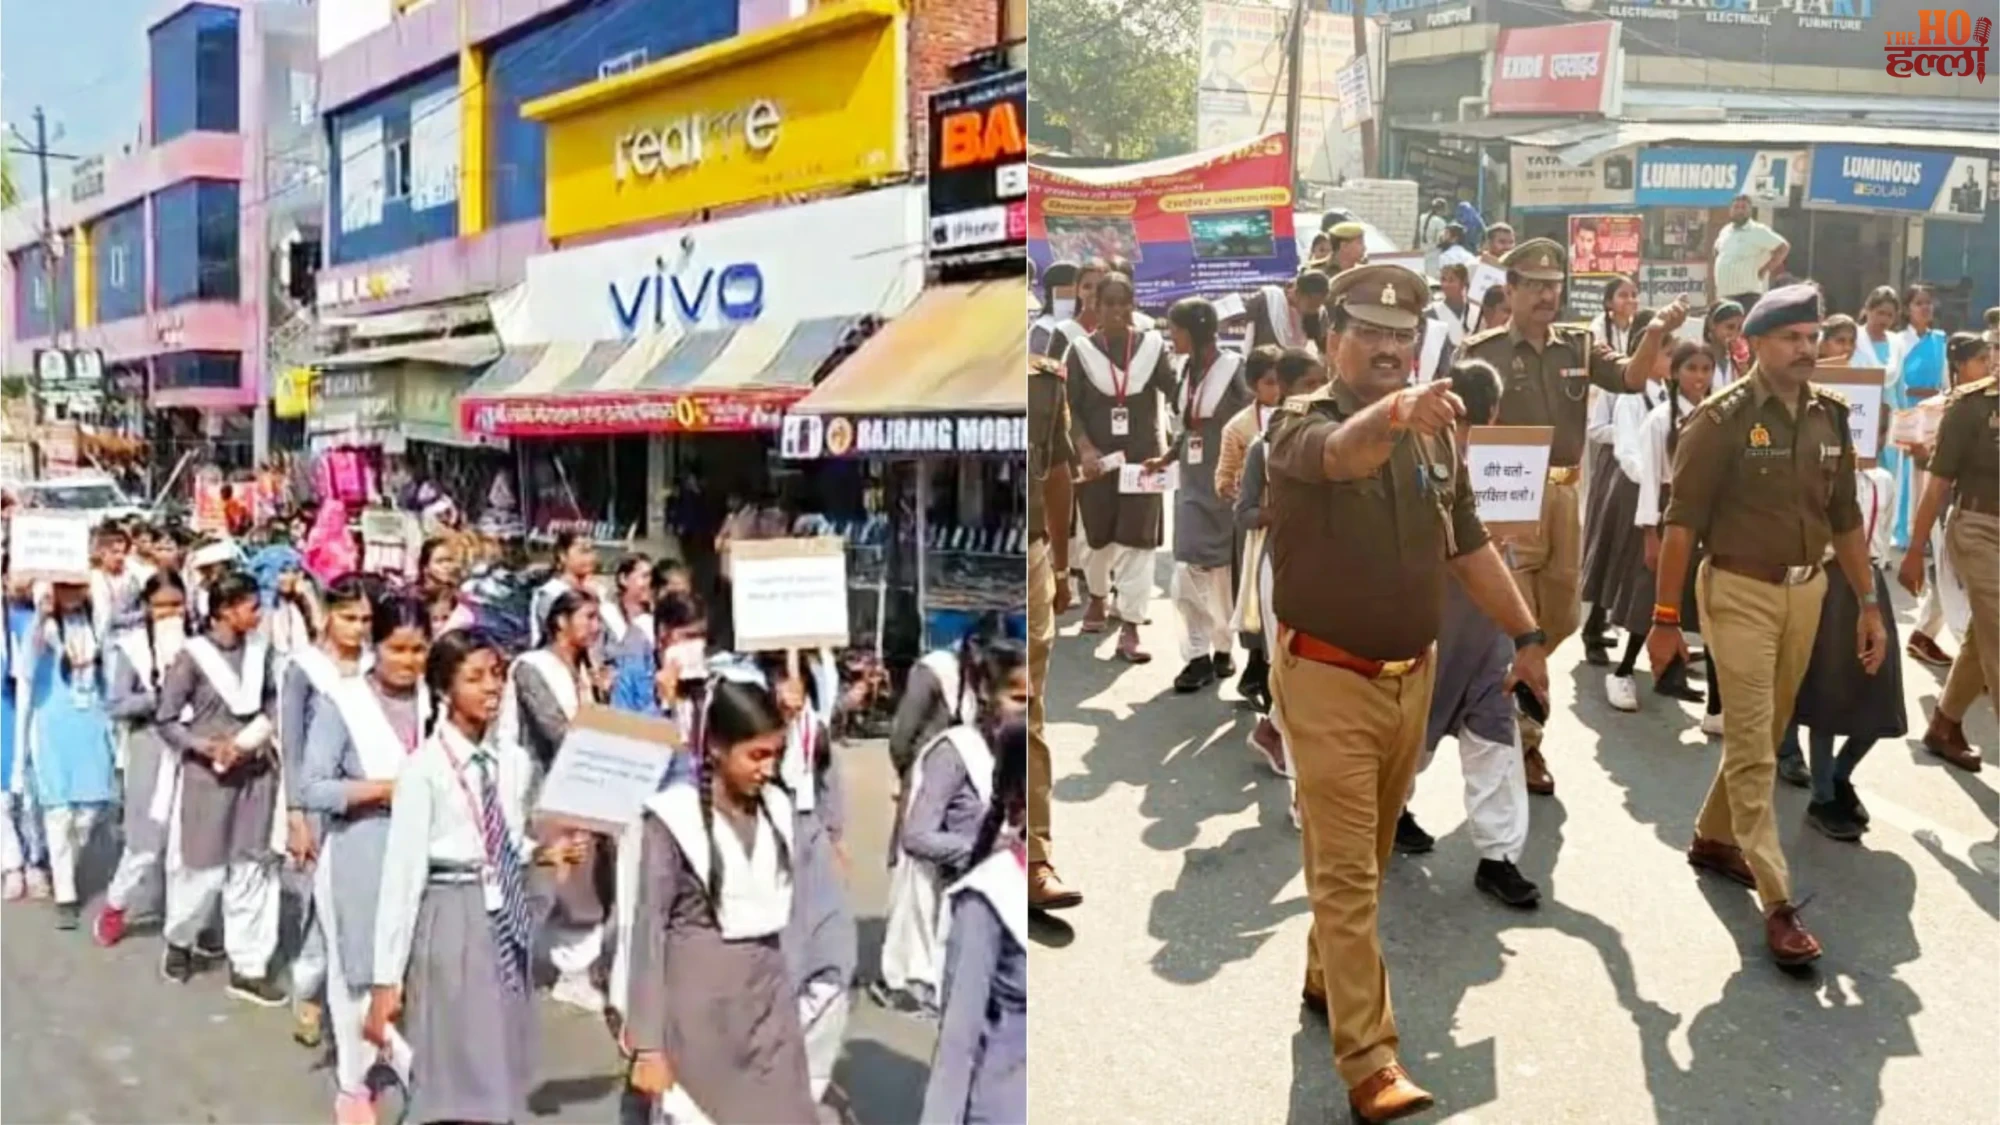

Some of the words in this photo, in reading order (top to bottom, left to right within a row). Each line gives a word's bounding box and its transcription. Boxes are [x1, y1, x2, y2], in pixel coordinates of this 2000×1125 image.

[1608, 5, 1679, 20] ELECTRONICS
[1705, 11, 1772, 26] ELECTRICAL
[1798, 16, 1862, 31] FURNITURE
[941, 102, 1027, 169] BA
[1641, 162, 1738, 190] LUMINOUS
[1842, 155, 1922, 186] LUMINOUS
[1863, 182, 1908, 198] SOLAR
[609, 255, 764, 332] vivo
